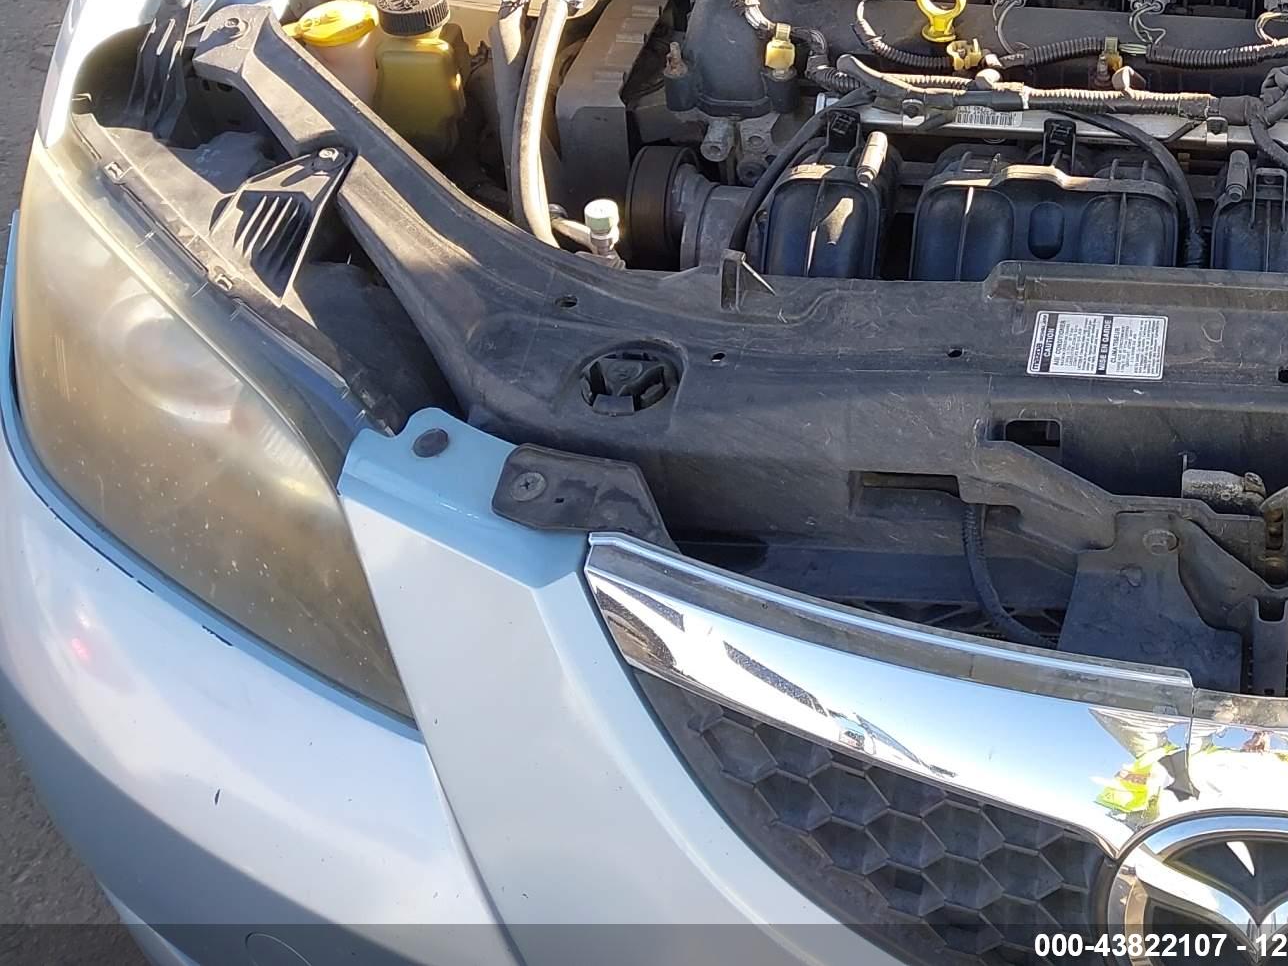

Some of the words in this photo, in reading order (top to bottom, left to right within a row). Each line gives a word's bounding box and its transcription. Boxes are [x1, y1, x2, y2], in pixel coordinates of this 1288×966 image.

[1043, 328, 1055, 357] CAUTION
[1055, 320, 1066, 355] CONDITIONER
[1102, 319, 1112, 343] GARDE
[1100, 343, 1109, 353] EN
[1097, 354, 1107, 371] MISE
